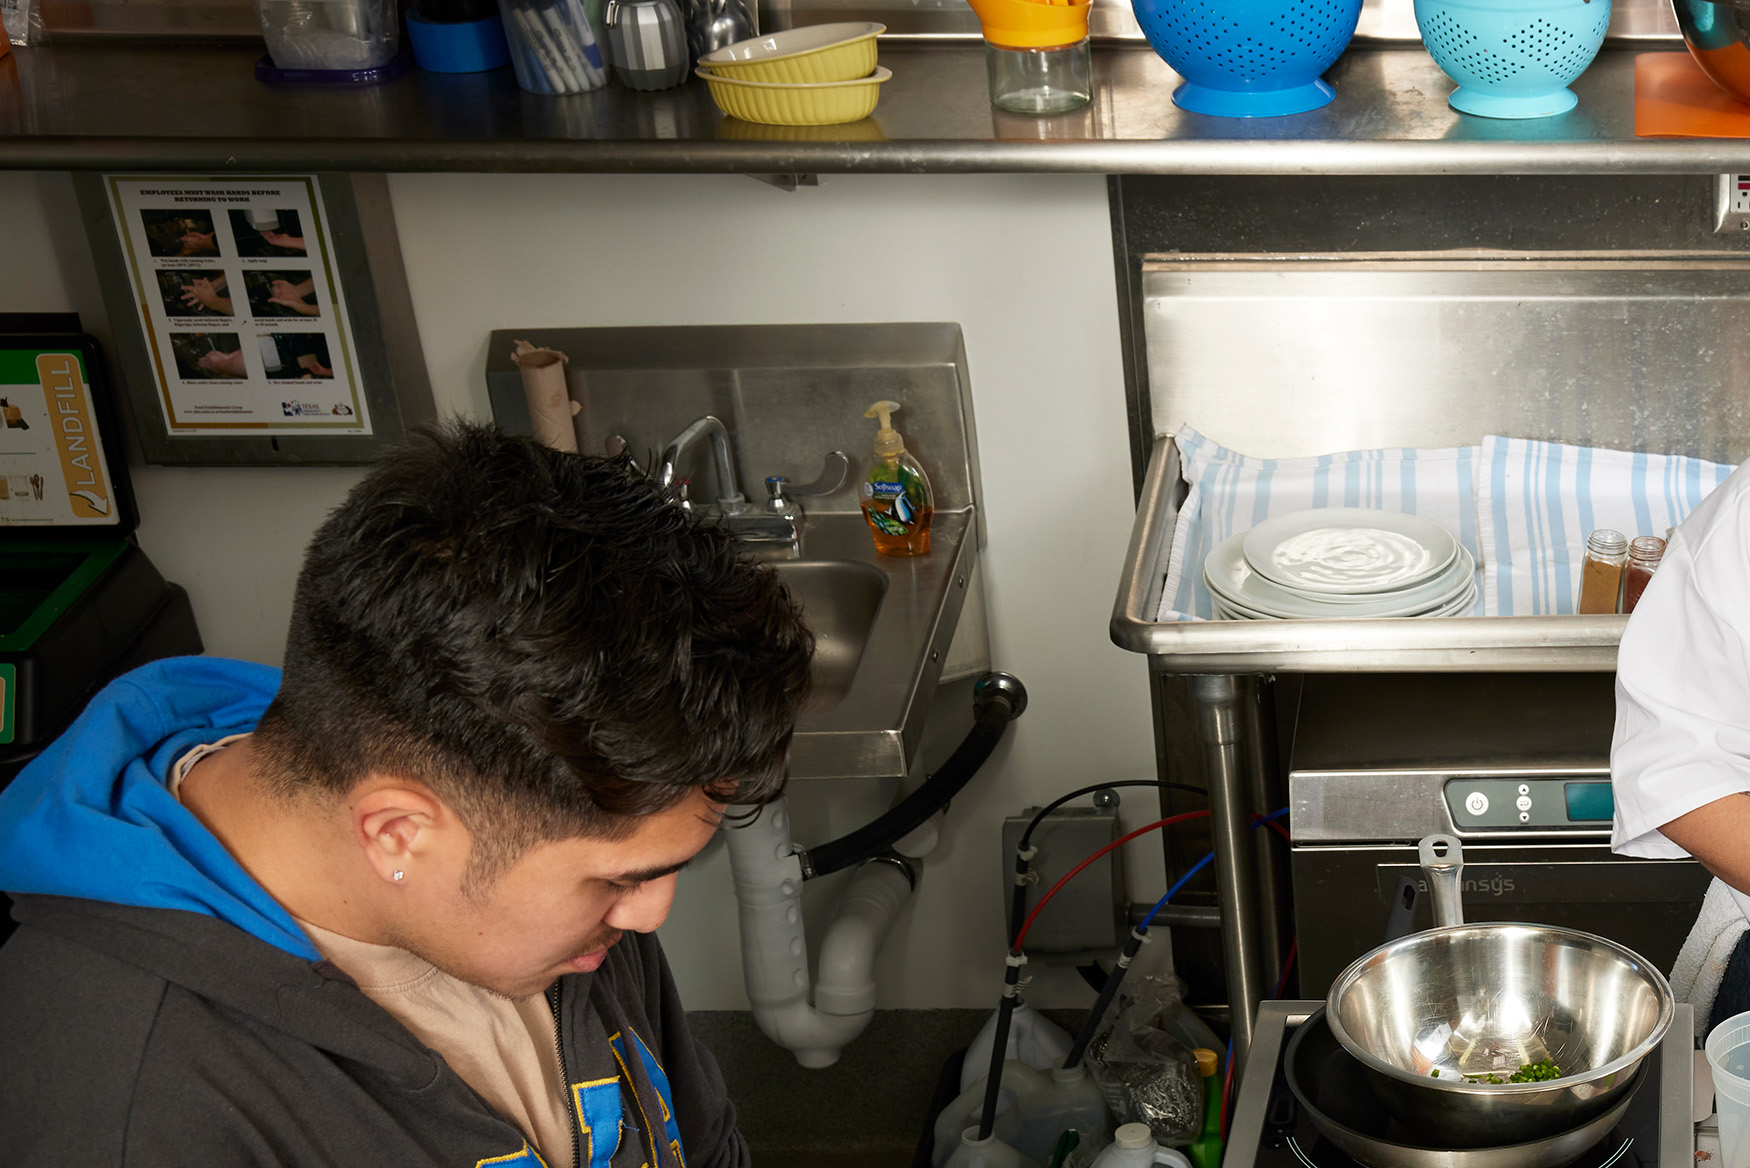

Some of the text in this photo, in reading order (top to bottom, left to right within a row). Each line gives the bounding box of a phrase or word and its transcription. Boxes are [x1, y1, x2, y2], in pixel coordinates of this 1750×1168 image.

[50, 360, 95, 485] LANDFILL
[874, 482, 902, 492] Softsoap
[1418, 872, 1516, 896] ansys
